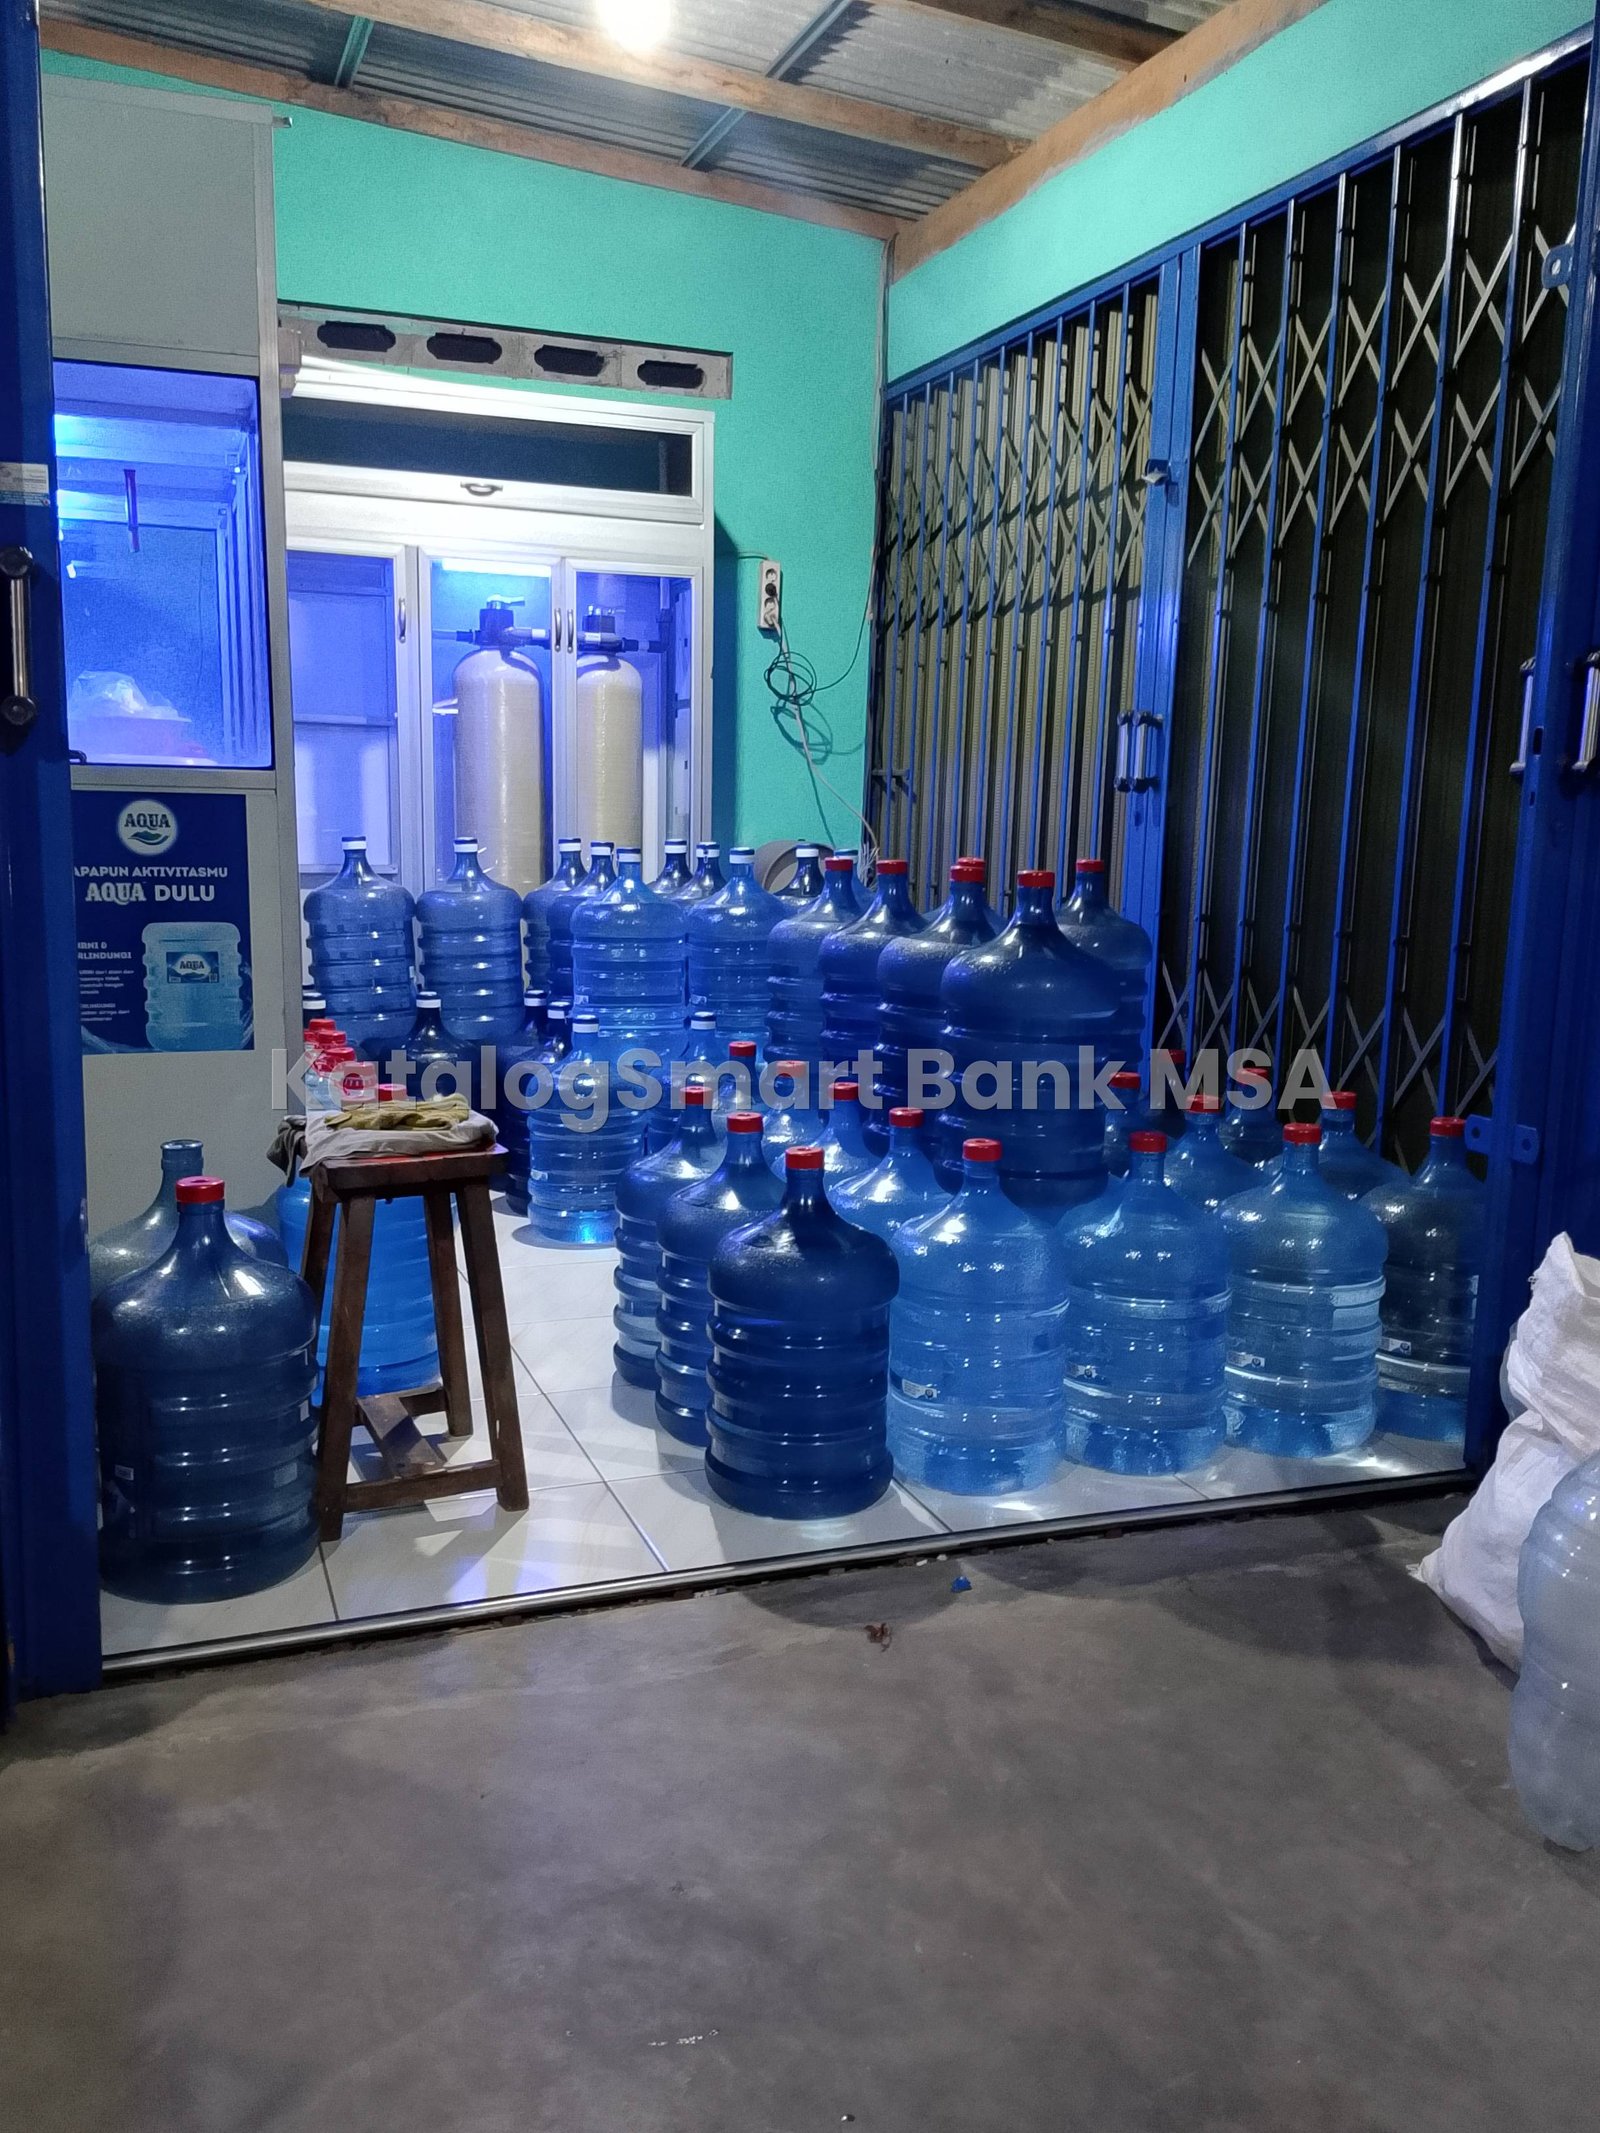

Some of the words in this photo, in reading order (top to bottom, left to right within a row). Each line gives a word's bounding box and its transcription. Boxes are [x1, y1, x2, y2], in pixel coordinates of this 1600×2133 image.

[124, 812, 171, 831] AQUA
[132, 866, 228, 878] AKTIVITASMU
[85, 881, 147, 906] AQUA
[154, 884, 215, 902] DULU
[77, 951, 132, 960] RLINDUNGI
[180, 960, 205, 970] AQUA
